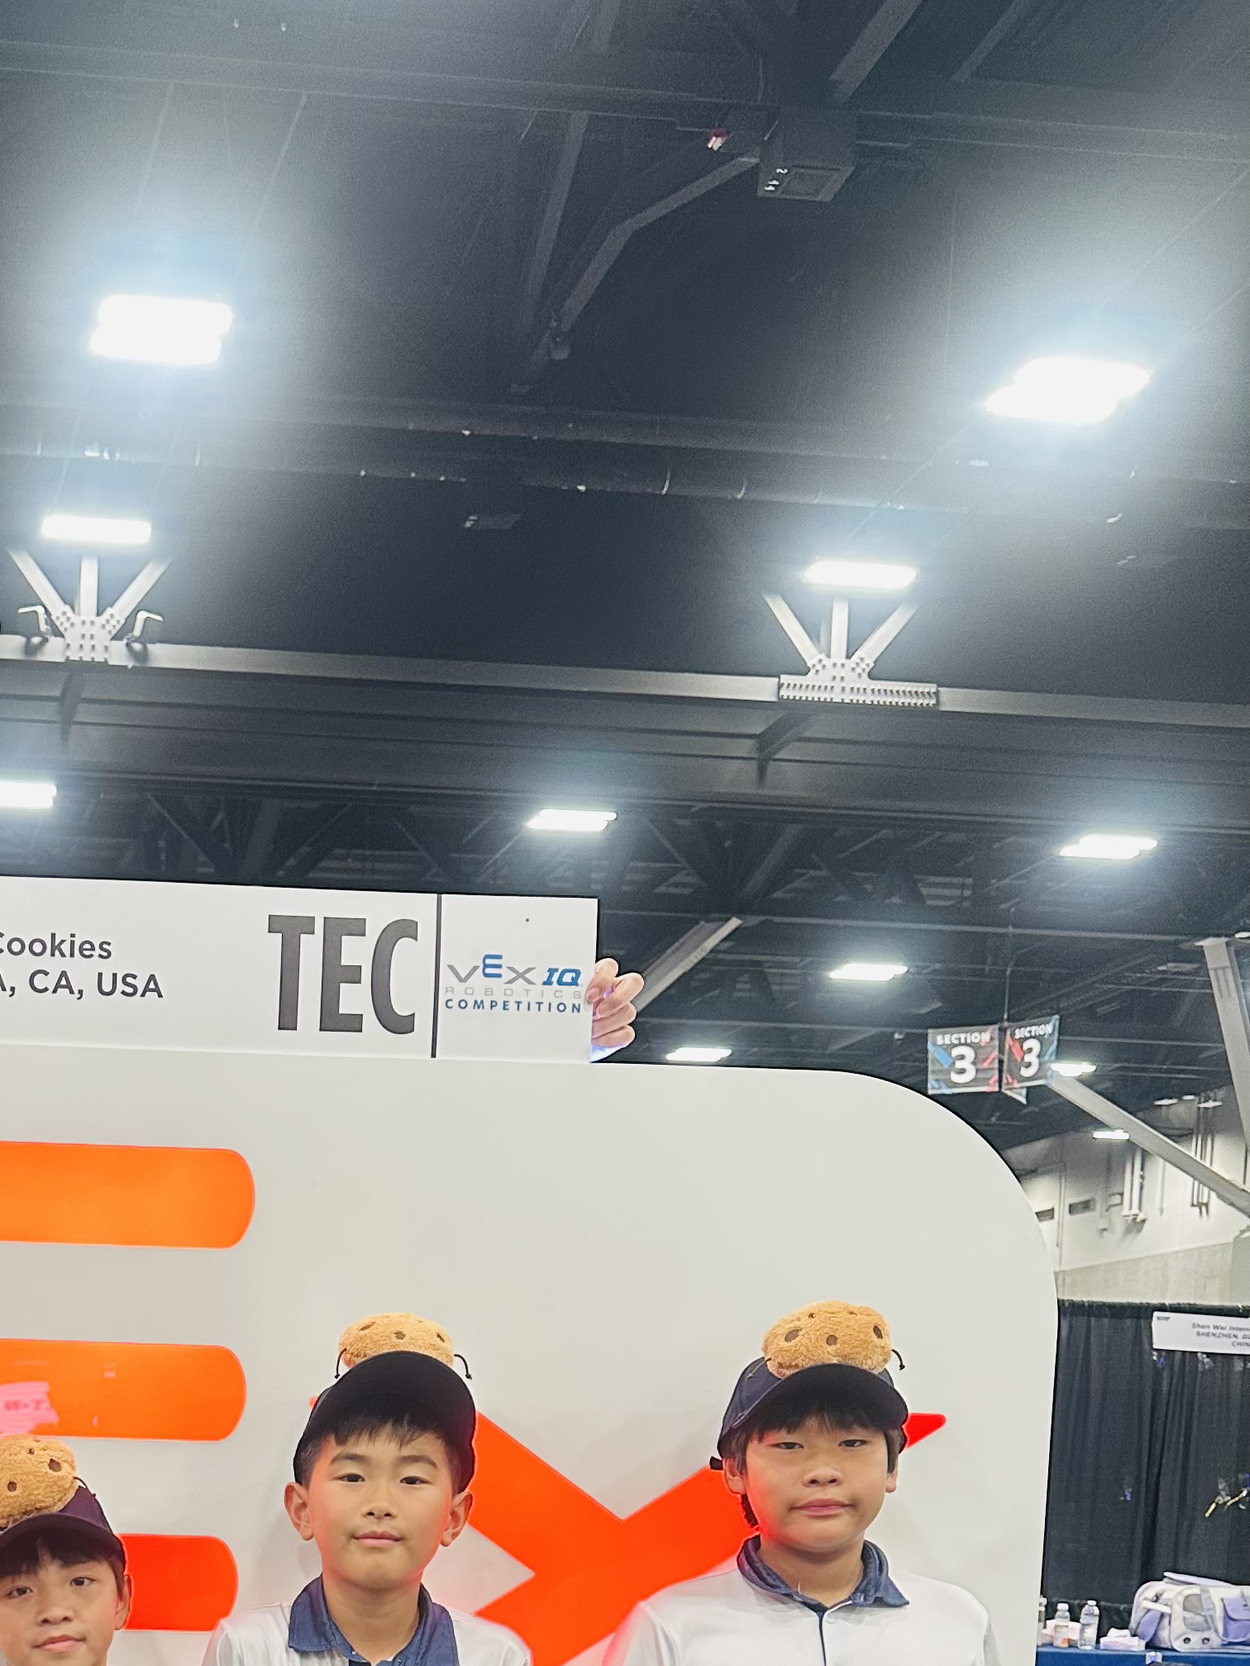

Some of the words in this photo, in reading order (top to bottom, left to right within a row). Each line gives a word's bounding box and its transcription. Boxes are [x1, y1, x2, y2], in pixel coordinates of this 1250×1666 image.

[268, 914, 419, 1035] TEC
[541, 967, 583, 987] IQ
[28, 969, 85, 1001] CA,
[96, 972, 164, 999] USA
[445, 986, 582, 999] ROBOTICS
[445, 998, 581, 1013] COMPETITION
[936, 1032, 991, 1045] SECTION
[1014, 1024, 1053, 1039] SECTION
[950, 1045, 976, 1084] 3
[1020, 1038, 1041, 1077] 3
